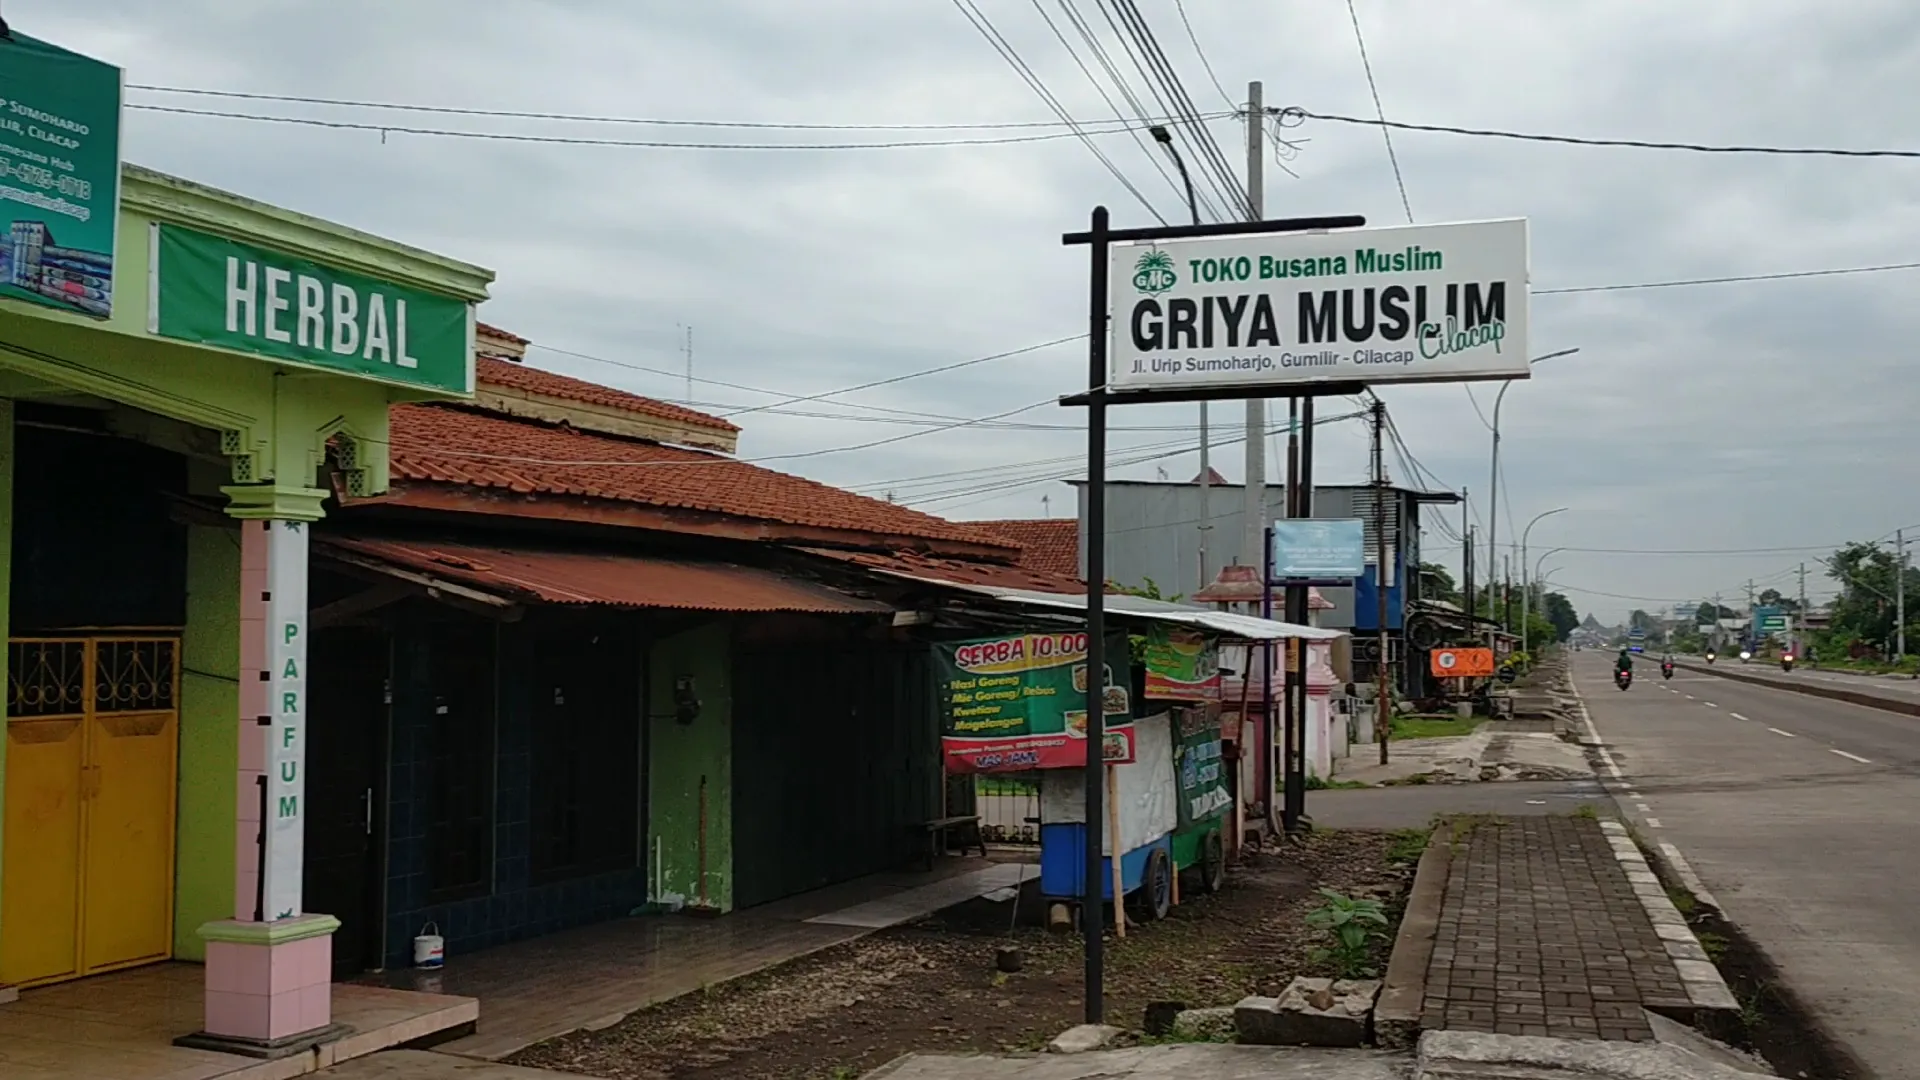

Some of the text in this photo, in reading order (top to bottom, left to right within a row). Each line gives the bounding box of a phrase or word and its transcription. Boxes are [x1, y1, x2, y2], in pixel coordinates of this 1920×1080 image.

[1189, 246, 1442, 283] TOKO Busana Muslim
[226, 256, 417, 368] HERBAL
[1131, 281, 1505, 352] GRIYA MUSLIM
[1419, 316, 1505, 360] Cilacap
[1131, 360, 1147, 373] Jl.
[1151, 359, 1182, 375] Urip
[1186, 355, 1276, 373] Sumoharjo,
[1281, 351, 1340, 368] Gumilir
[1353, 350, 1414, 366] Cilacap
[958, 634, 1088, 667] SERBA 10.00
[978, 676, 1019, 688] Goreng
[279, 623, 298, 818] PARFUM
